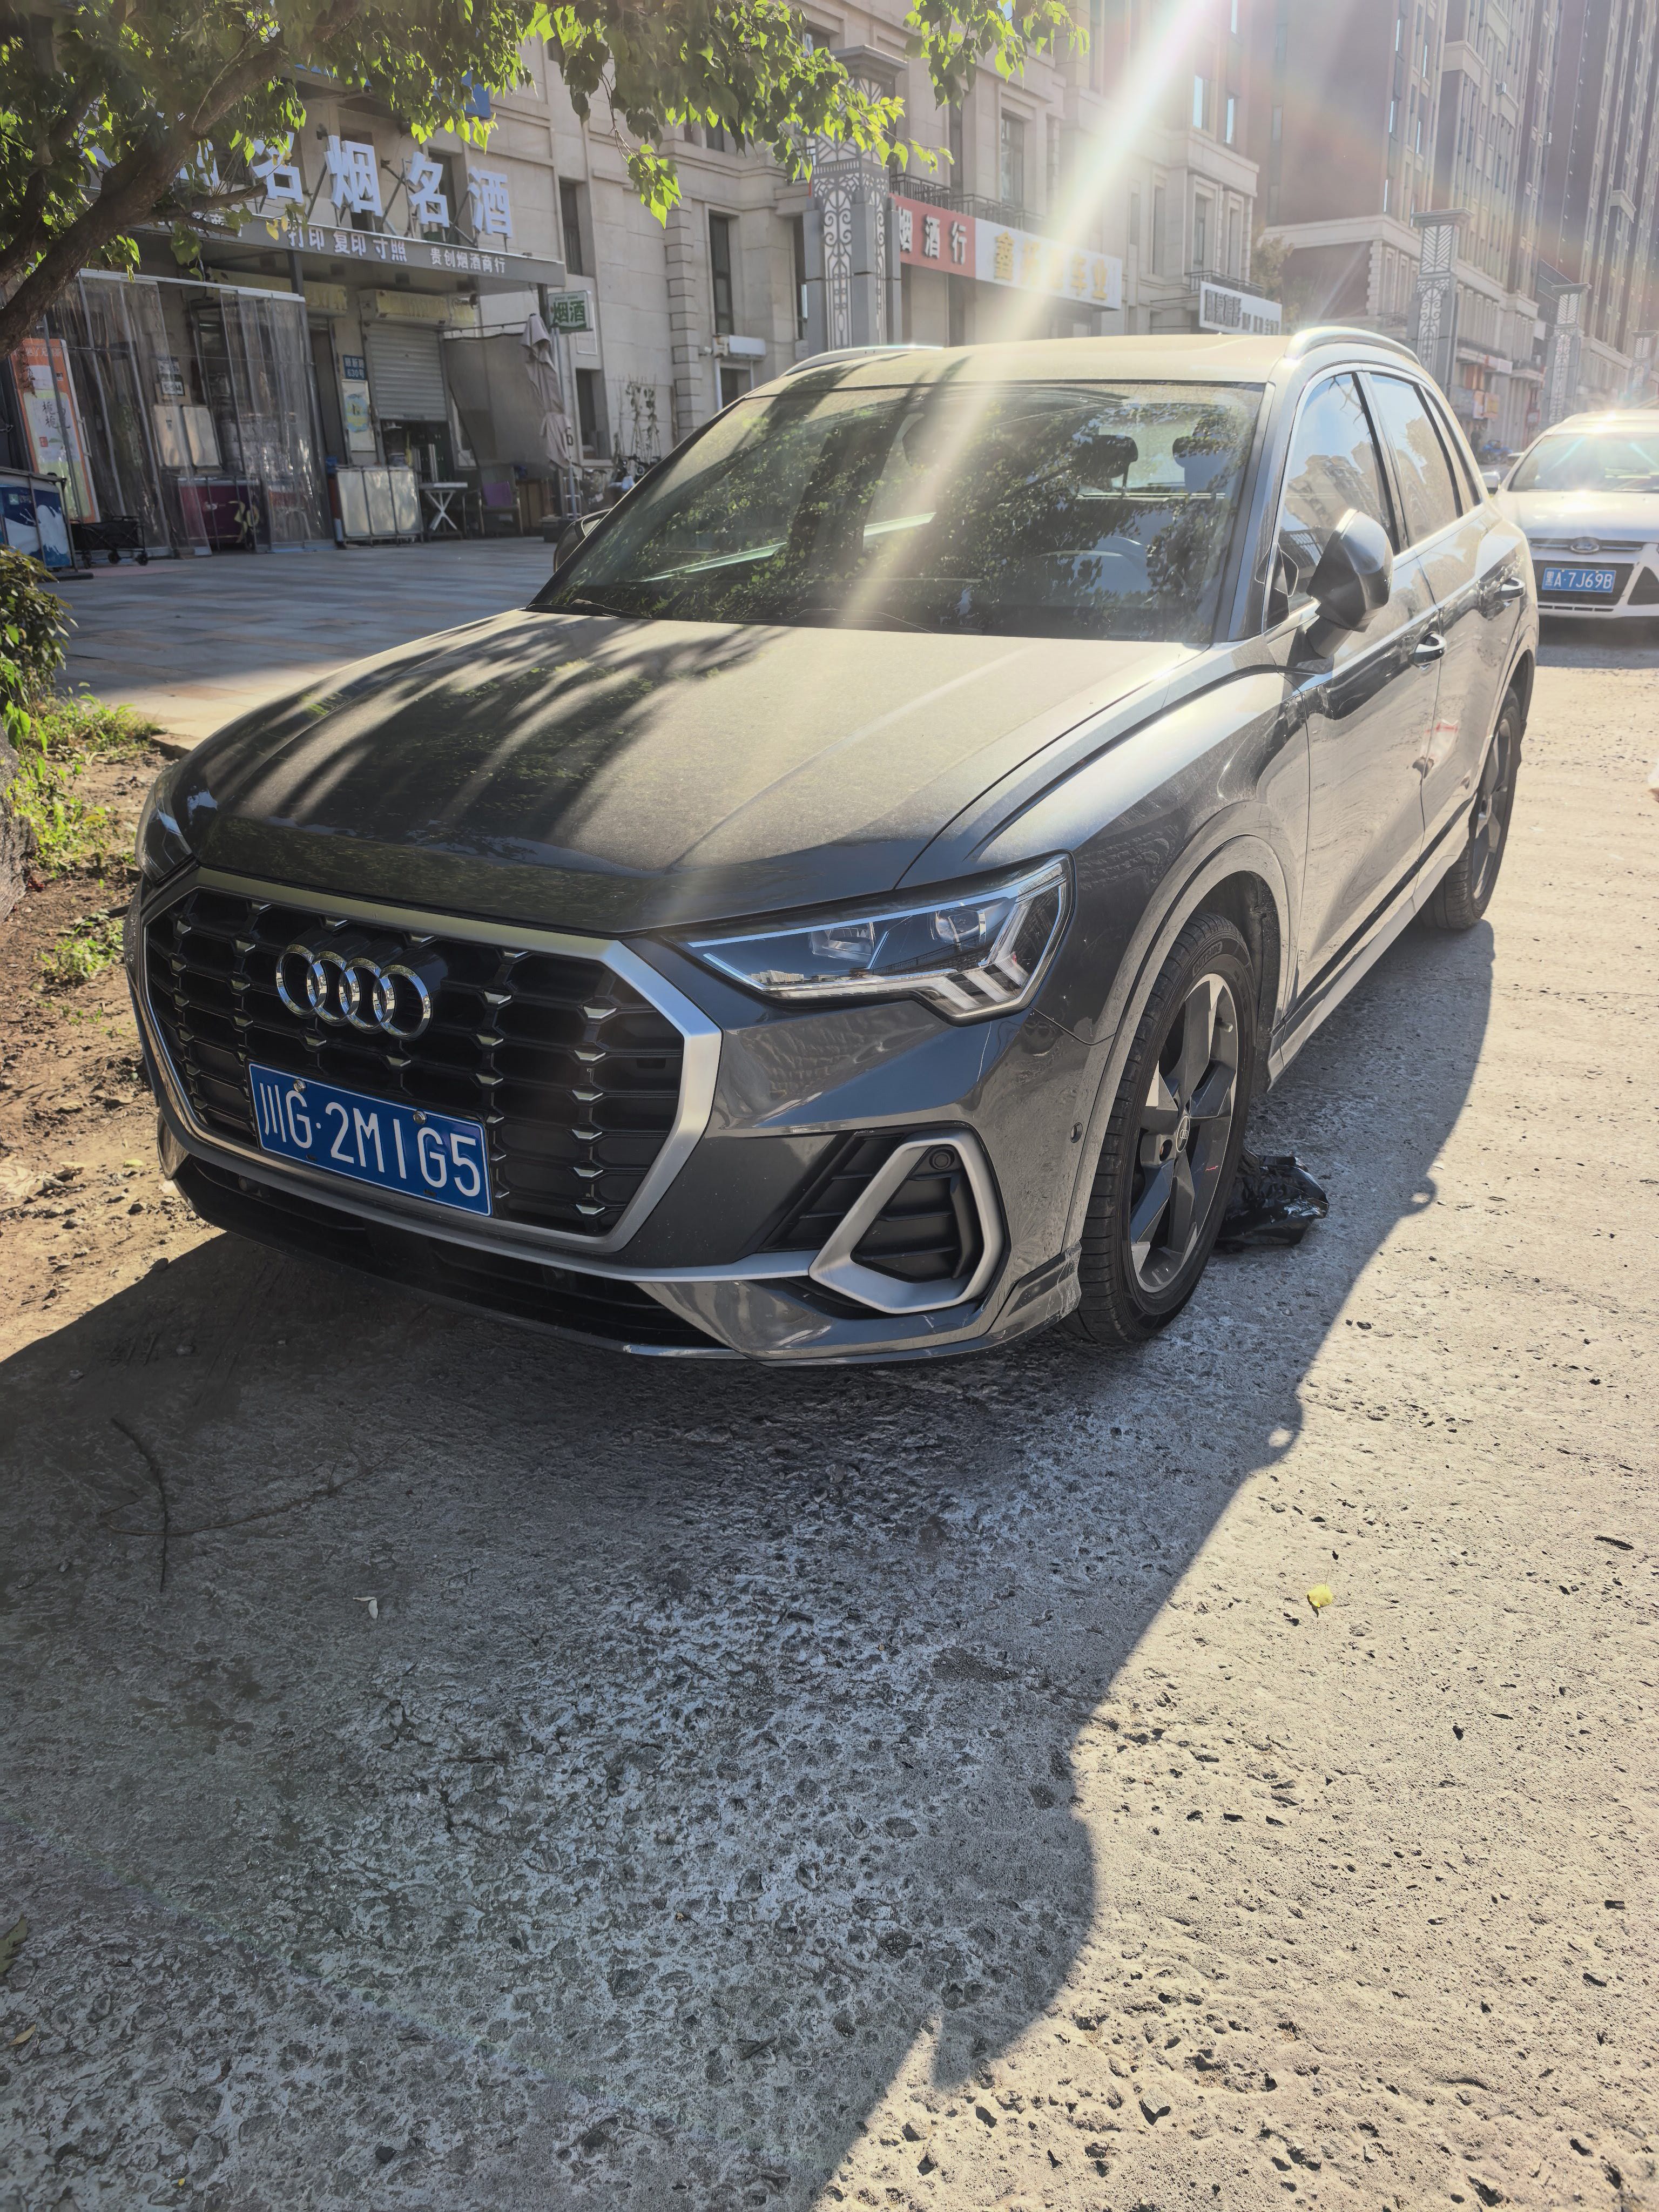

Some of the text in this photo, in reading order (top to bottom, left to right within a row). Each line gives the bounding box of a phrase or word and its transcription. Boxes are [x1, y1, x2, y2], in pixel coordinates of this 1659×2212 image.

[288, 224, 407, 262] 打印 复印 寸照
[430, 247, 505, 274] 贵创烟酒商行
[994, 230, 1108, 300] 鑫车业
[553, 300, 585, 322] 烟酒
